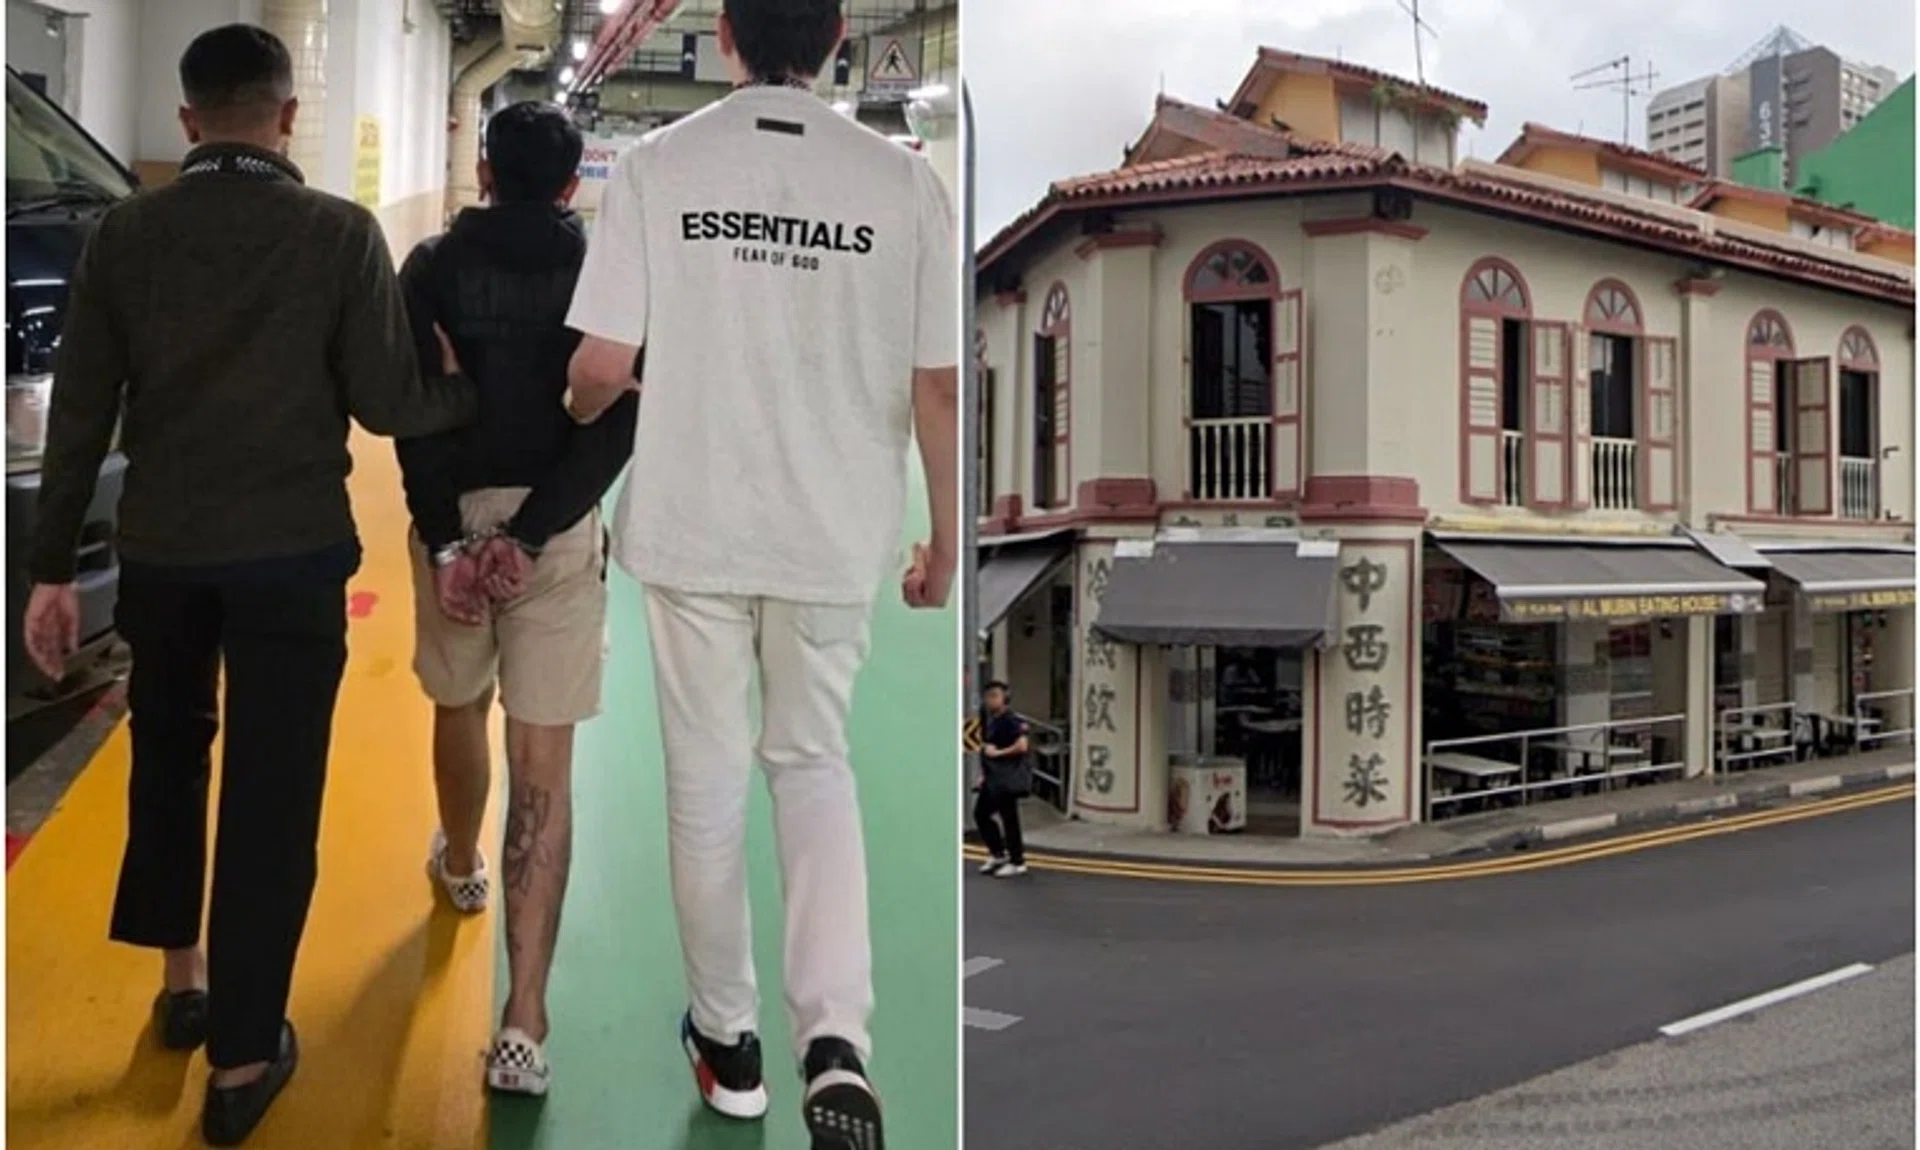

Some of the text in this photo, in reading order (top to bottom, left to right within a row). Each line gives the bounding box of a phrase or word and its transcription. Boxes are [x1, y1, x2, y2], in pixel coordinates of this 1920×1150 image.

[682, 211, 874, 254] ESSENTIALS
[734, 247, 820, 271] FEAR OF GOD
[1583, 599, 1600, 615] AL
[1640, 595, 1680, 614] EATING
[1682, 594, 1722, 611] HOUSE
[1340, 555, 1391, 808] 中西時菜
